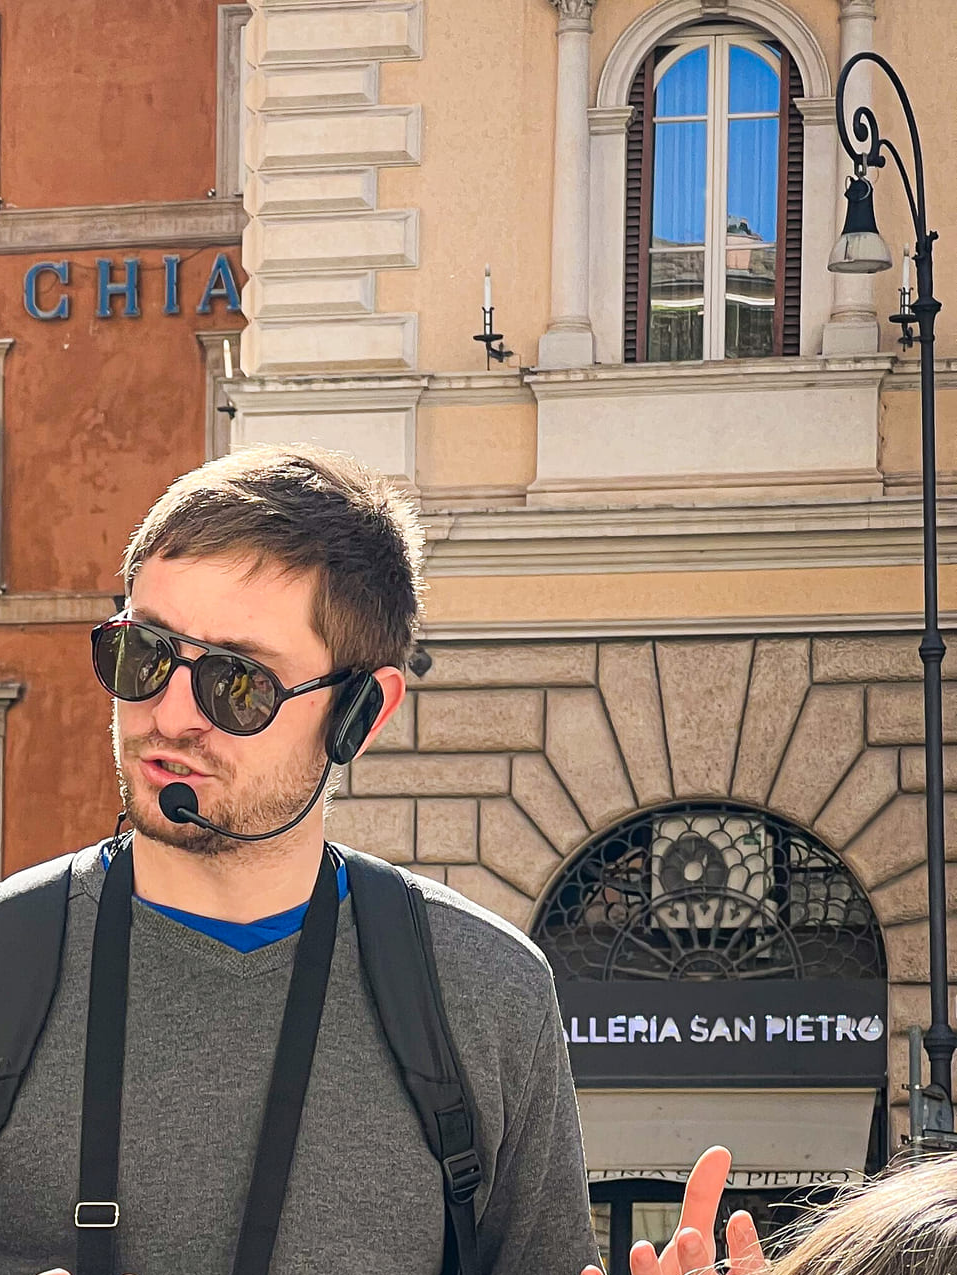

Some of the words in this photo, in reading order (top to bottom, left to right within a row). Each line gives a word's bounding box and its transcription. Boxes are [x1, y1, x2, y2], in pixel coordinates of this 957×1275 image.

[23, 253, 242, 320] CHIA
[690, 1015, 756, 1042] SAN
[765, 1015, 884, 1042] PIETRO
[747, 1171, 850, 1186] PIETRO
